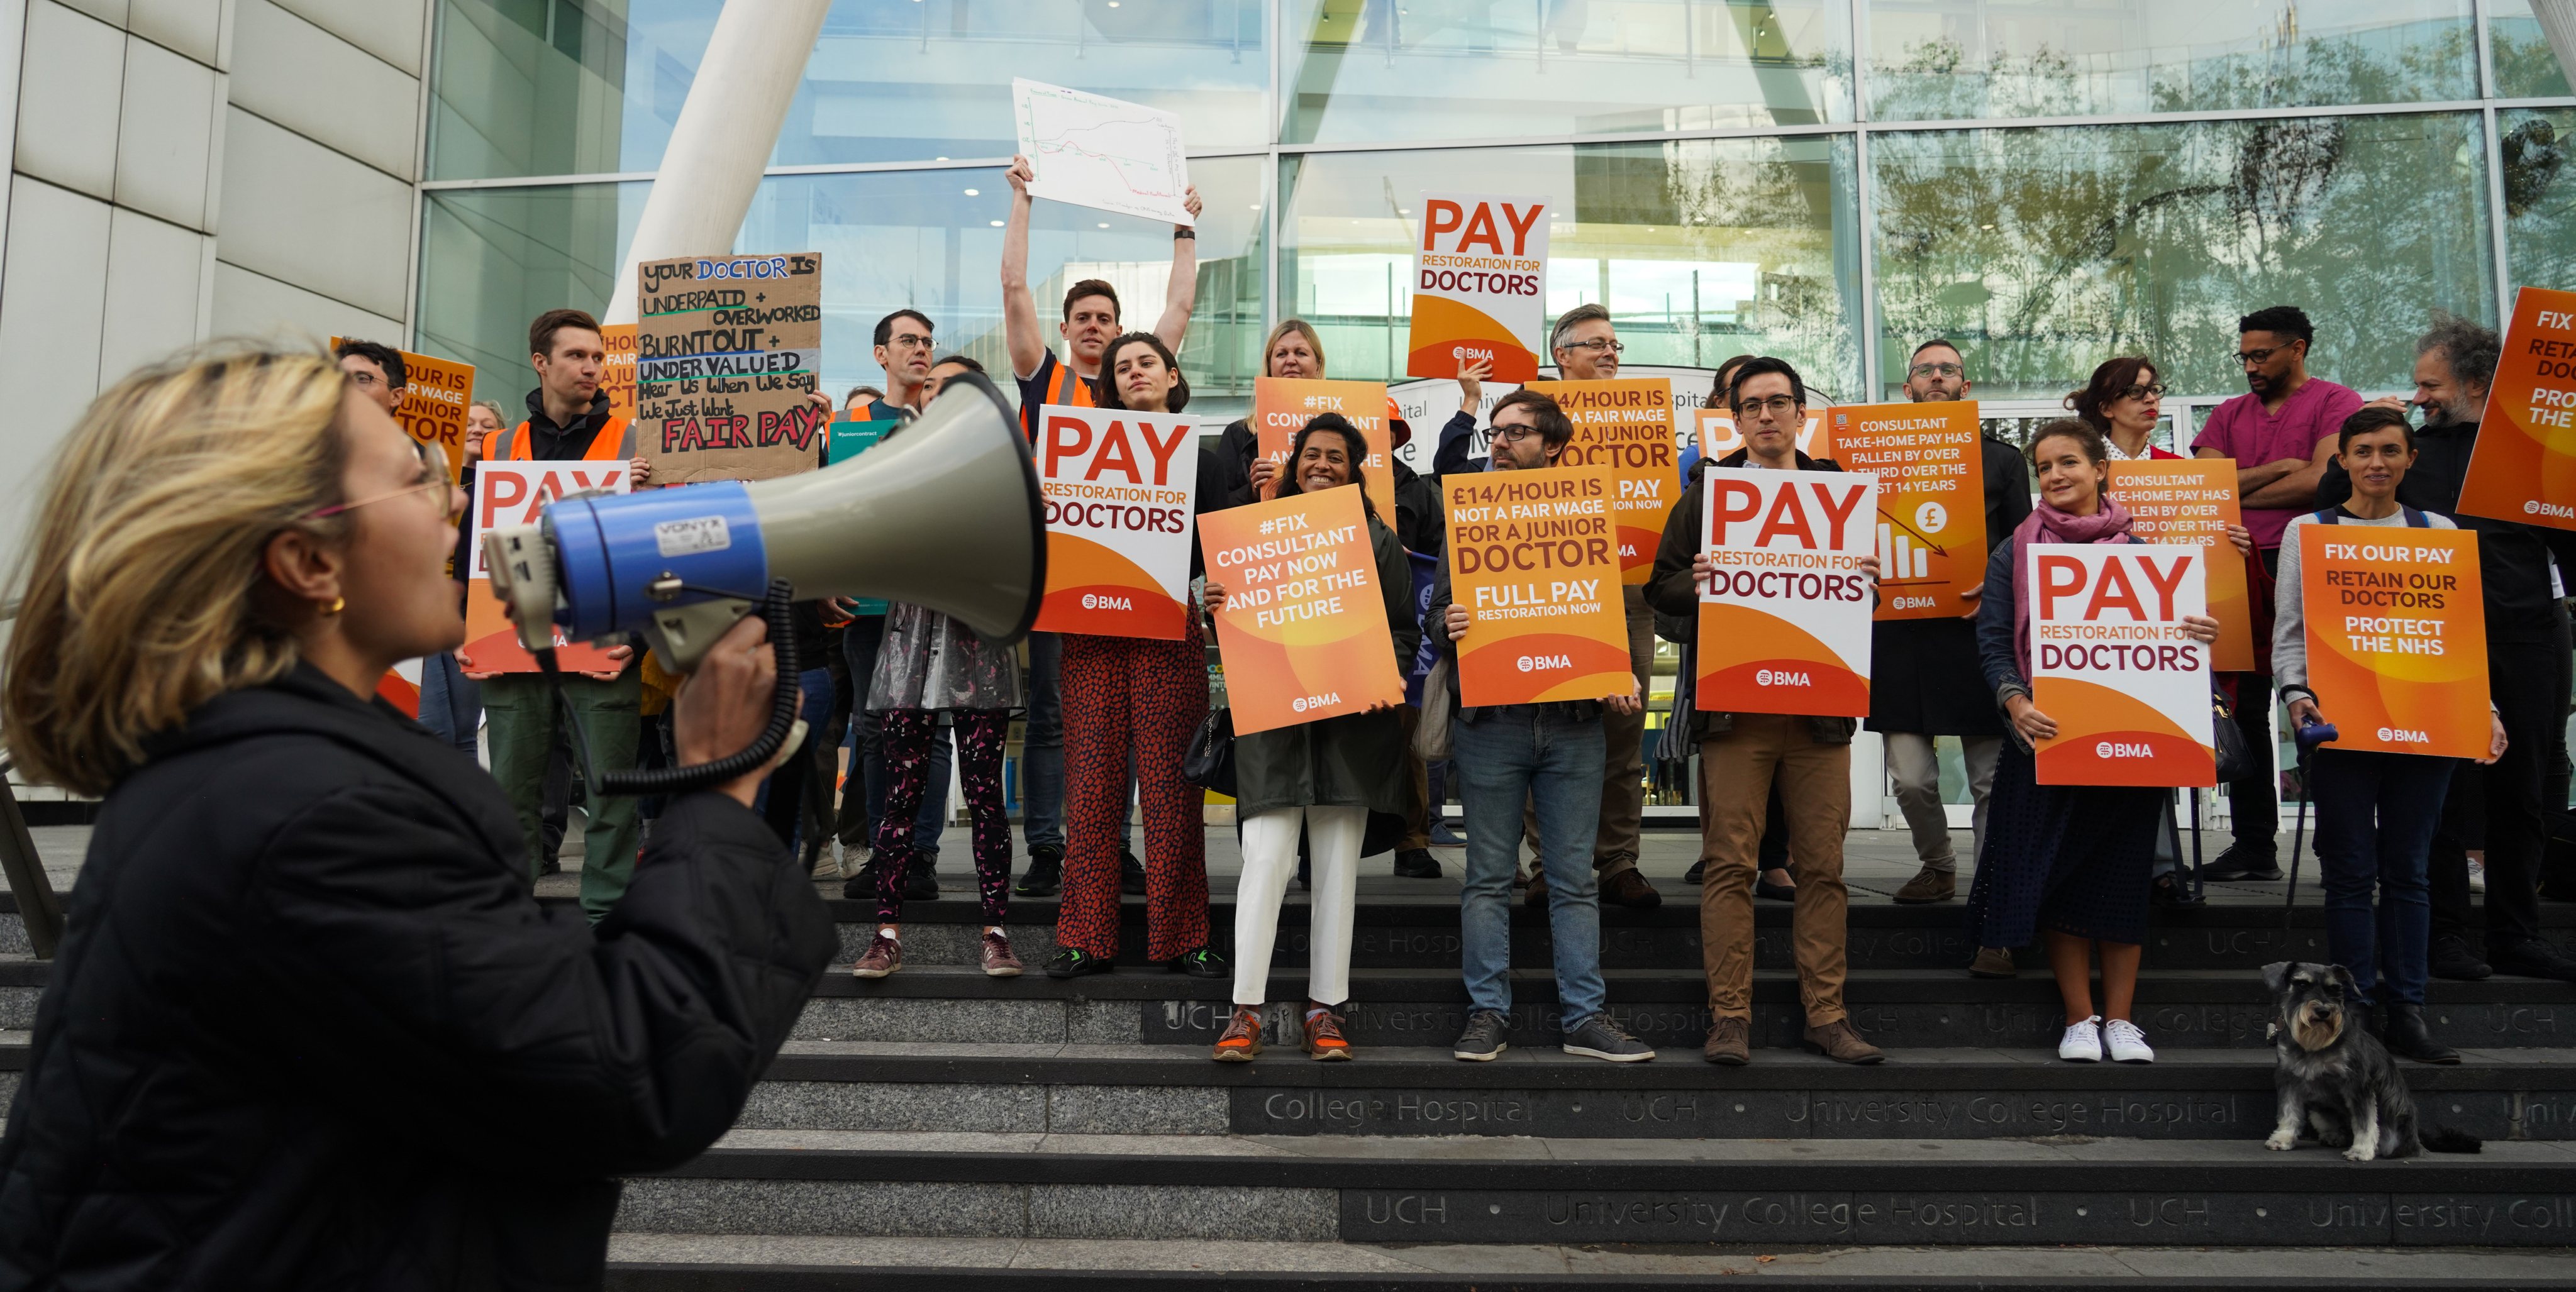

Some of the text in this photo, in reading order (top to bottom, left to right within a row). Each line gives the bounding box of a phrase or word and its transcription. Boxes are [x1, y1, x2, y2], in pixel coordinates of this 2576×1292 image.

[1424, 200, 1544, 256] PAY
[1423, 255, 1540, 271] RESTORATION FOR
[645, 257, 816, 293] YOUR DOCTOR IS
[1421, 270, 1538, 295] DOCTORS
[643, 290, 745, 314] UNDERPAID
[713, 305, 820, 326] OVERWORKED
[2538, 311, 2573, 329] FIX
[607, 353, 636, 365] FAIR
[1467, 348, 1494, 362] BMA
[448, 373, 465, 389] IS
[638, 382, 672, 400] Hear
[680, 379, 699, 395] Us
[707, 377, 749, 394] When
[756, 375, 783, 392] We
[786, 373, 815, 394] Say
[421, 385, 463, 404] WAGE
[1304, 396, 1343, 410] #FIX
[1646, 390, 1664, 406] IS
[401, 398, 461, 421] UNIOR
[640, 397, 736, 421] We Just Want
[1586, 411, 1619, 422] FAIR
[1622, 409, 1666, 422] WAGE
[2530, 407, 2573, 428] THE
[392, 412, 460, 446] TOR
[662, 402, 819, 453] FAIR PAY
[1580, 428, 1594, 441] A
[1598, 425, 1668, 444] JUNIOR
[1860, 417, 1947, 432] CONSULTANT
[1702, 417, 1819, 461] PY
[1837, 433, 1972, 448] TAKE-HOME PAY HAS
[1045, 416, 1190, 485] PAY
[1561, 443, 1670, 468] OCTOR
[1852, 448, 1959, 463] FALLEN BY OVER
[1902, 465, 1938, 477] OVER
[1940, 464, 1966, 475] THE
[2116, 475, 2204, 486] CONSULTANT
[1042, 483, 1186, 504] RESTORATION FOR
[1453, 478, 1602, 505] £14/HOUR IS
[1619, 479, 1660, 498] PAY
[1896, 482, 1911, 492] 14
[1913, 480, 1956, 492] YEARS
[2110, 490, 2229, 501] KE-HOME PAY HAS
[1454, 507, 1490, 522] NOT
[1495, 507, 1507, 520] A
[1512, 504, 1550, 519] FAIR
[1553, 500, 1604, 516] WAGE
[1636, 500, 1662, 509] NOW
[1712, 479, 1867, 550] PAY
[2162, 506, 2177, 516] BY
[2181, 505, 2217, 516] OVER
[2540, 504, 2573, 519] BMA
[1045, 500, 1185, 534] DOCTORS
[1260, 513, 1308, 534] #FIX
[1925, 509, 1938, 526] £
[2133, 521, 2225, 531] IRD OVER THE
[1456, 517, 1607, 543] FOR A JUNIOR
[1217, 525, 1357, 567] CONSULTANT
[1618, 544, 1637, 556] MA
[2168, 536, 2214, 548] YEARS
[1458, 538, 1610, 574] DOCTOR
[1711, 551, 1865, 571] RESTORATION FOR
[2326, 544, 2453, 563] FIX OUR PAY
[1245, 551, 1336, 584] PAY NOW
[1226, 569, 1367, 611] AND FOR THE
[1709, 570, 1864, 602] DOCTORS
[2038, 555, 2192, 621] PAY
[2327, 570, 2457, 590] RETAIN OUR
[1099, 596, 1131, 610] BMA
[1476, 580, 1599, 607] FULL PAY
[1907, 597, 1935, 608] BMA
[2341, 590, 2445, 609] DOCTORS
[1257, 597, 1343, 627] FUTURE
[1478, 603, 1600, 620] RESTORATION NOW
[2041, 626, 2158, 639] RESTORATION
[2346, 617, 2444, 636] PROTECT
[2348, 636, 2443, 655] THE NHS
[1535, 655, 1572, 670] BMA
[2041, 644, 2199, 671] DOCTORS
[1775, 671, 1810, 686] BMA
[1308, 692, 1341, 709] BMA
[2394, 730, 2429, 743] BMA
[2115, 744, 2153, 757] BMA
[1165, 1006, 1233, 1030] UCH
[2156, 1007, 2268, 1039] College
[2486, 1007, 2557, 1034] UCH
[1265, 1093, 1533, 1130] College Hospital
[1624, 1093, 1697, 1122] UCH
[1784, 1094, 2237, 1131] University College Hospital
[1366, 1195, 1447, 1224] UCH
[1545, 1194, 2038, 1234] University College Hospital
[2128, 1196, 2210, 1227] UCH
[2309, 1196, 2576, 1237] University Coll
